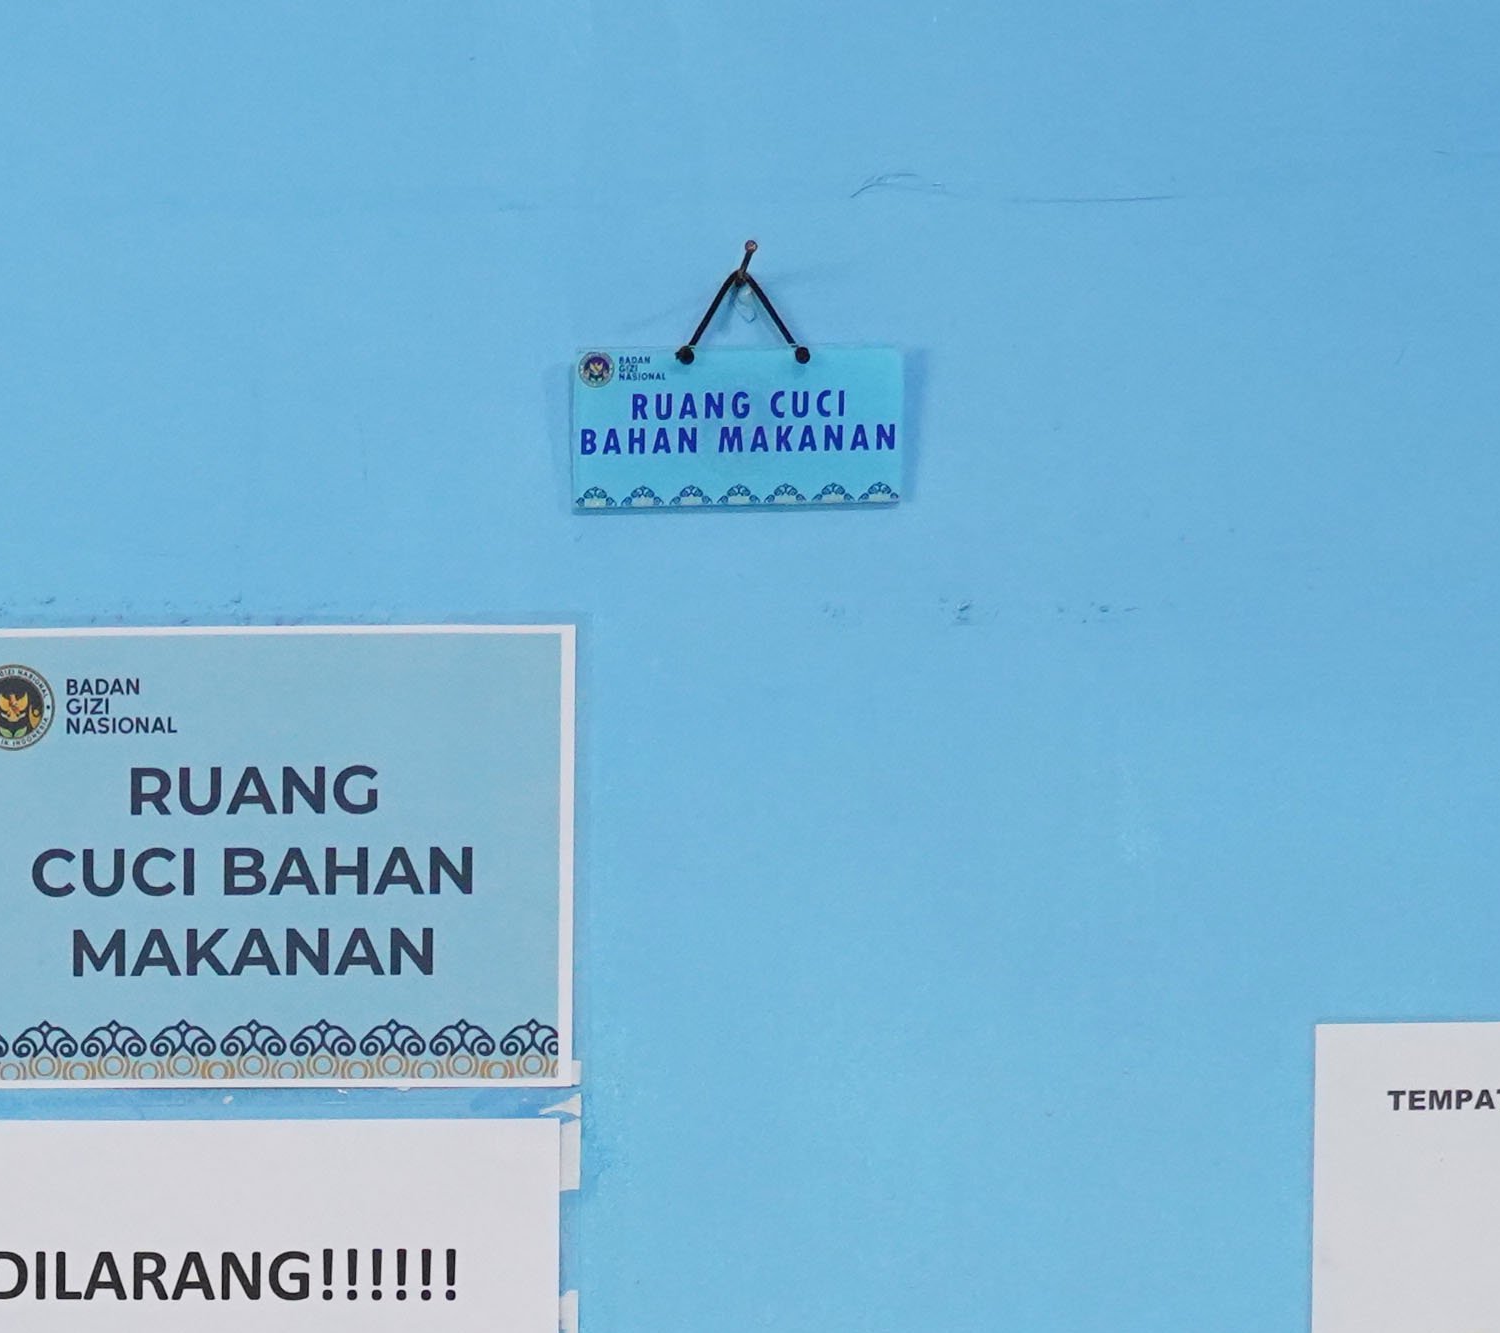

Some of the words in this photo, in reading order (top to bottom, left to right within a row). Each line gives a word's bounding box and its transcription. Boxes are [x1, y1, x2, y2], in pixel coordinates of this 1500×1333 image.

[618, 356, 651, 364] BADAN
[618, 373, 667, 381] NASIONAL
[631, 390, 752, 421] RUANG
[769, 389, 847, 419] CUCI
[580, 426, 699, 456] BAHAN
[717, 424, 897, 454] MAKANAN
[66, 678, 141, 696] BADAN
[65, 698, 110, 715] GIZI
[66, 716, 178, 735] NASIONAL
[130, 764, 379, 816] RUANG
[31, 848, 195, 897] CUCI
[223, 846, 473, 896] BAHAN
[72, 927, 434, 977] MAKANAN
